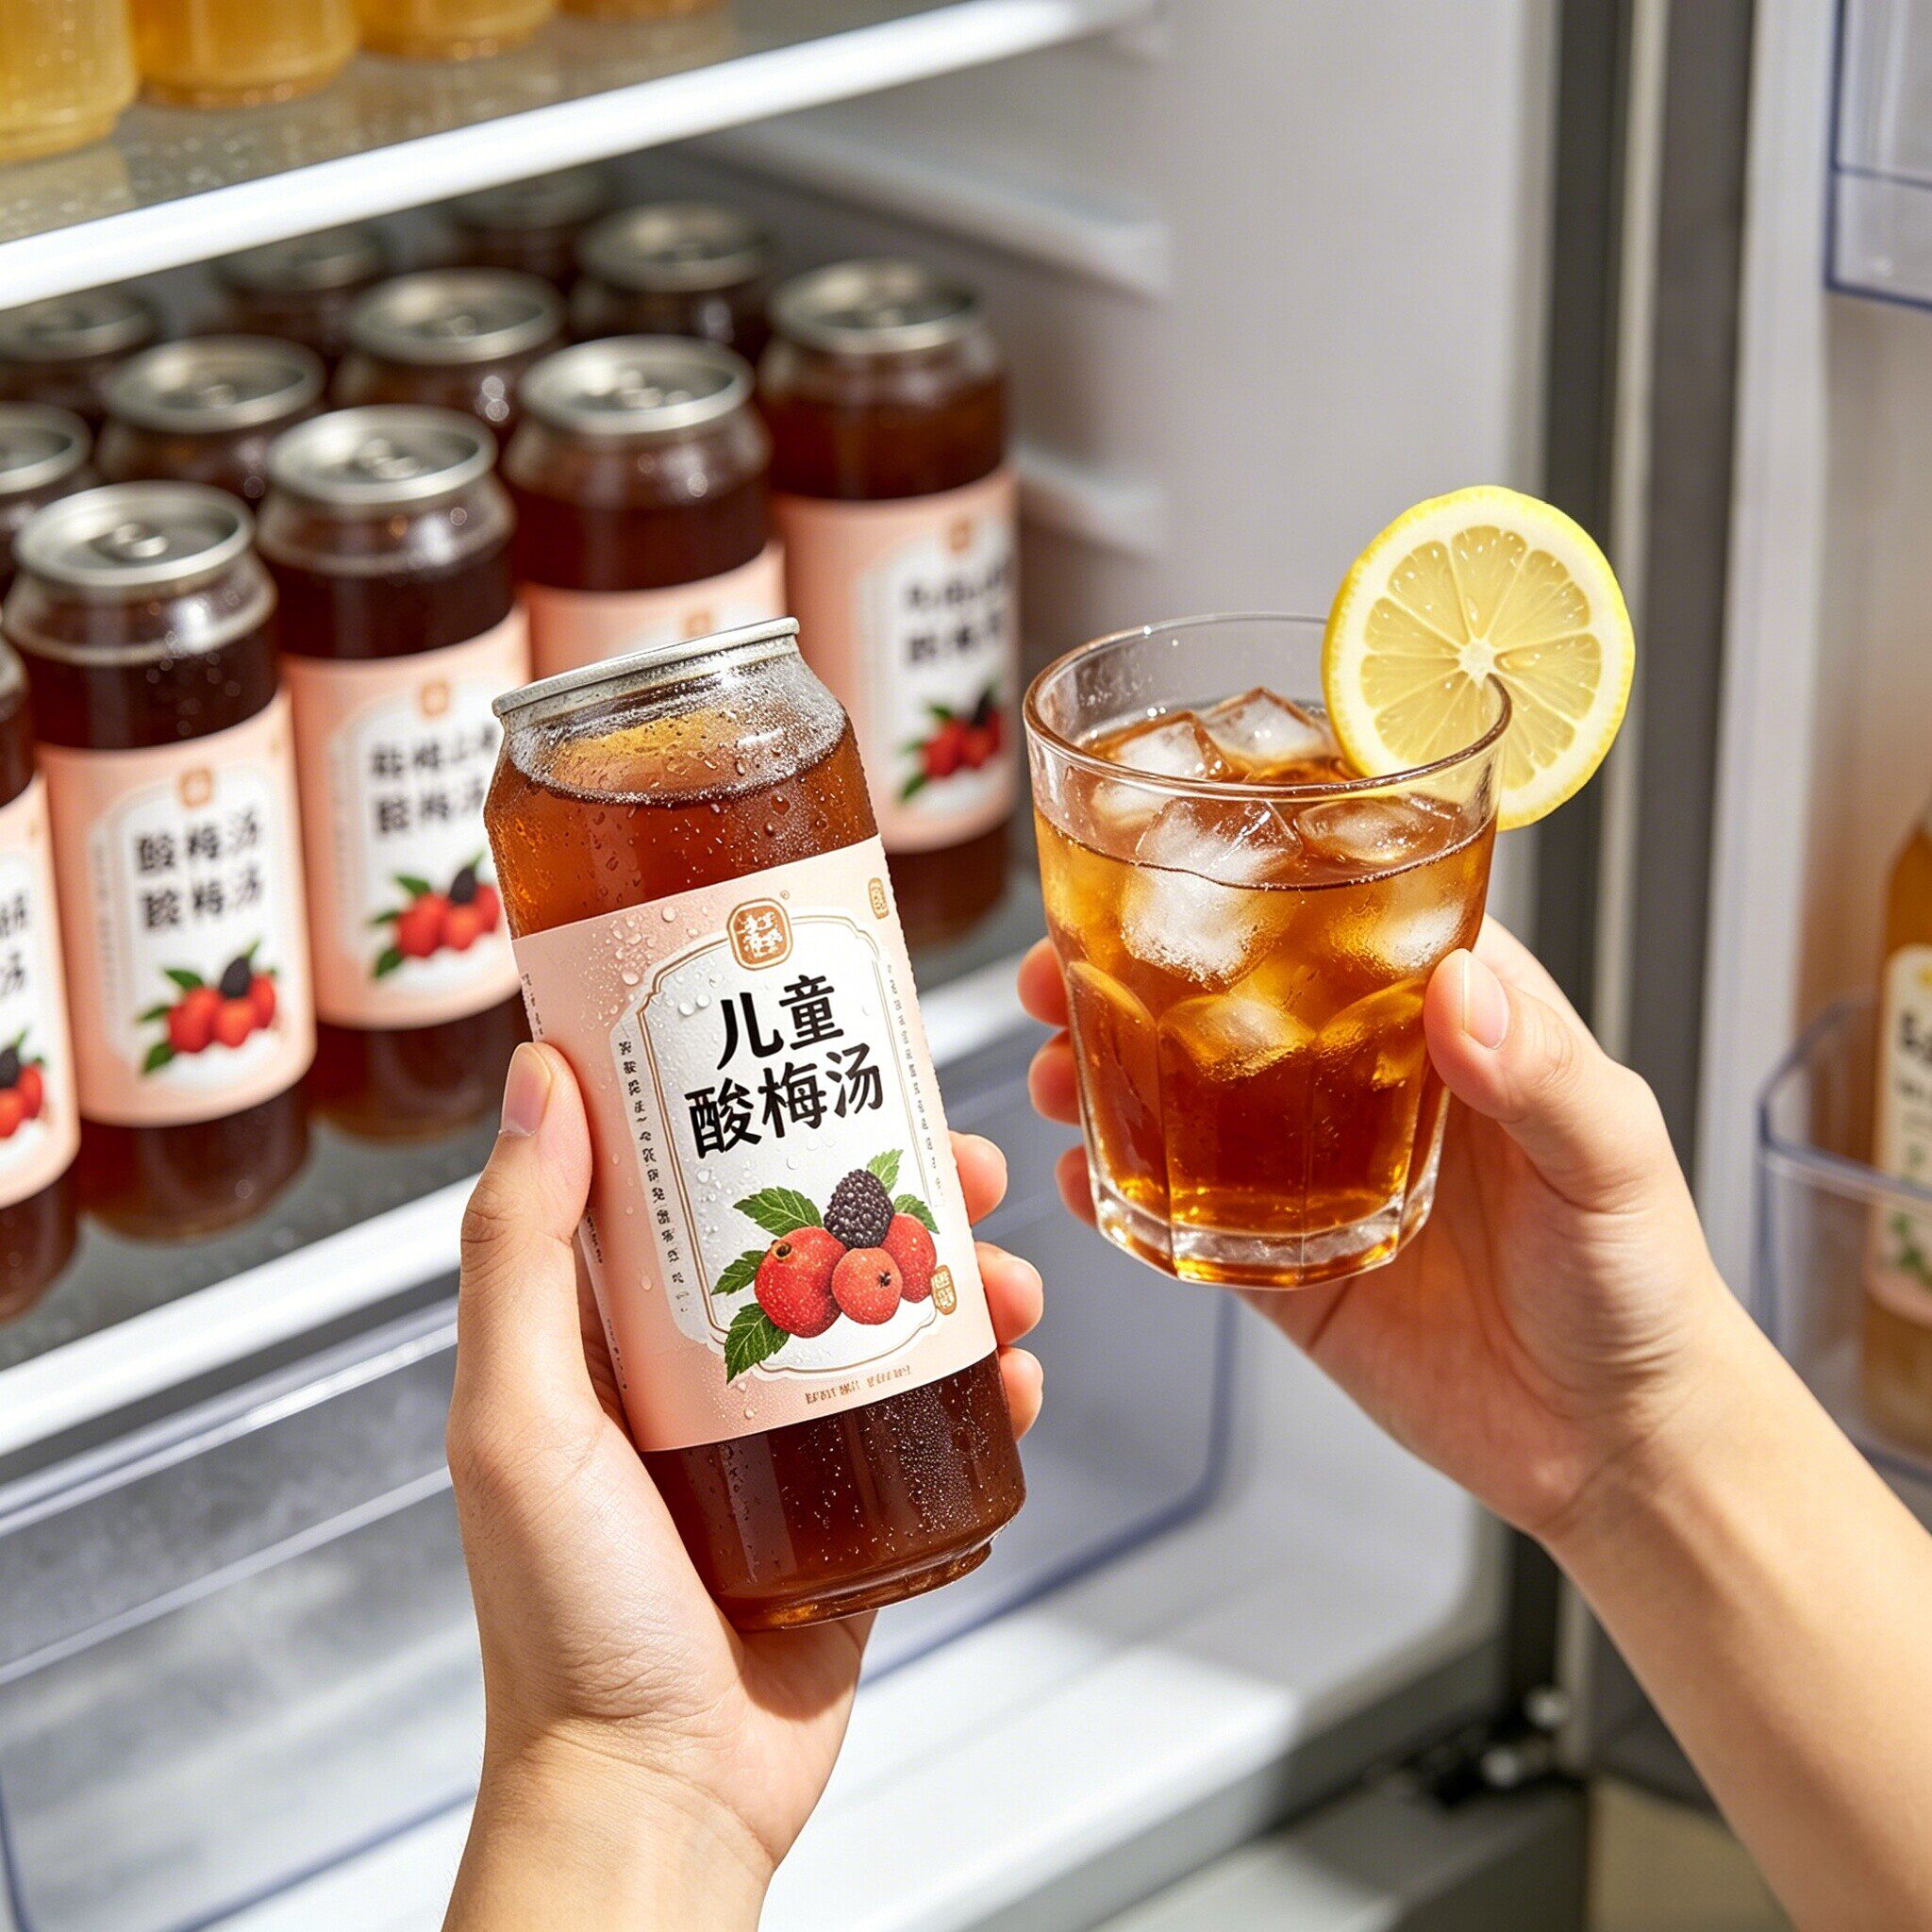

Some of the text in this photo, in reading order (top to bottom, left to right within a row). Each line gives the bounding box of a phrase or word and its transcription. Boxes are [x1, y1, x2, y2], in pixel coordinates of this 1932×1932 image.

[716, 974, 845, 1071] 儿童
[683, 1041, 884, 1159] 酸梅汤
